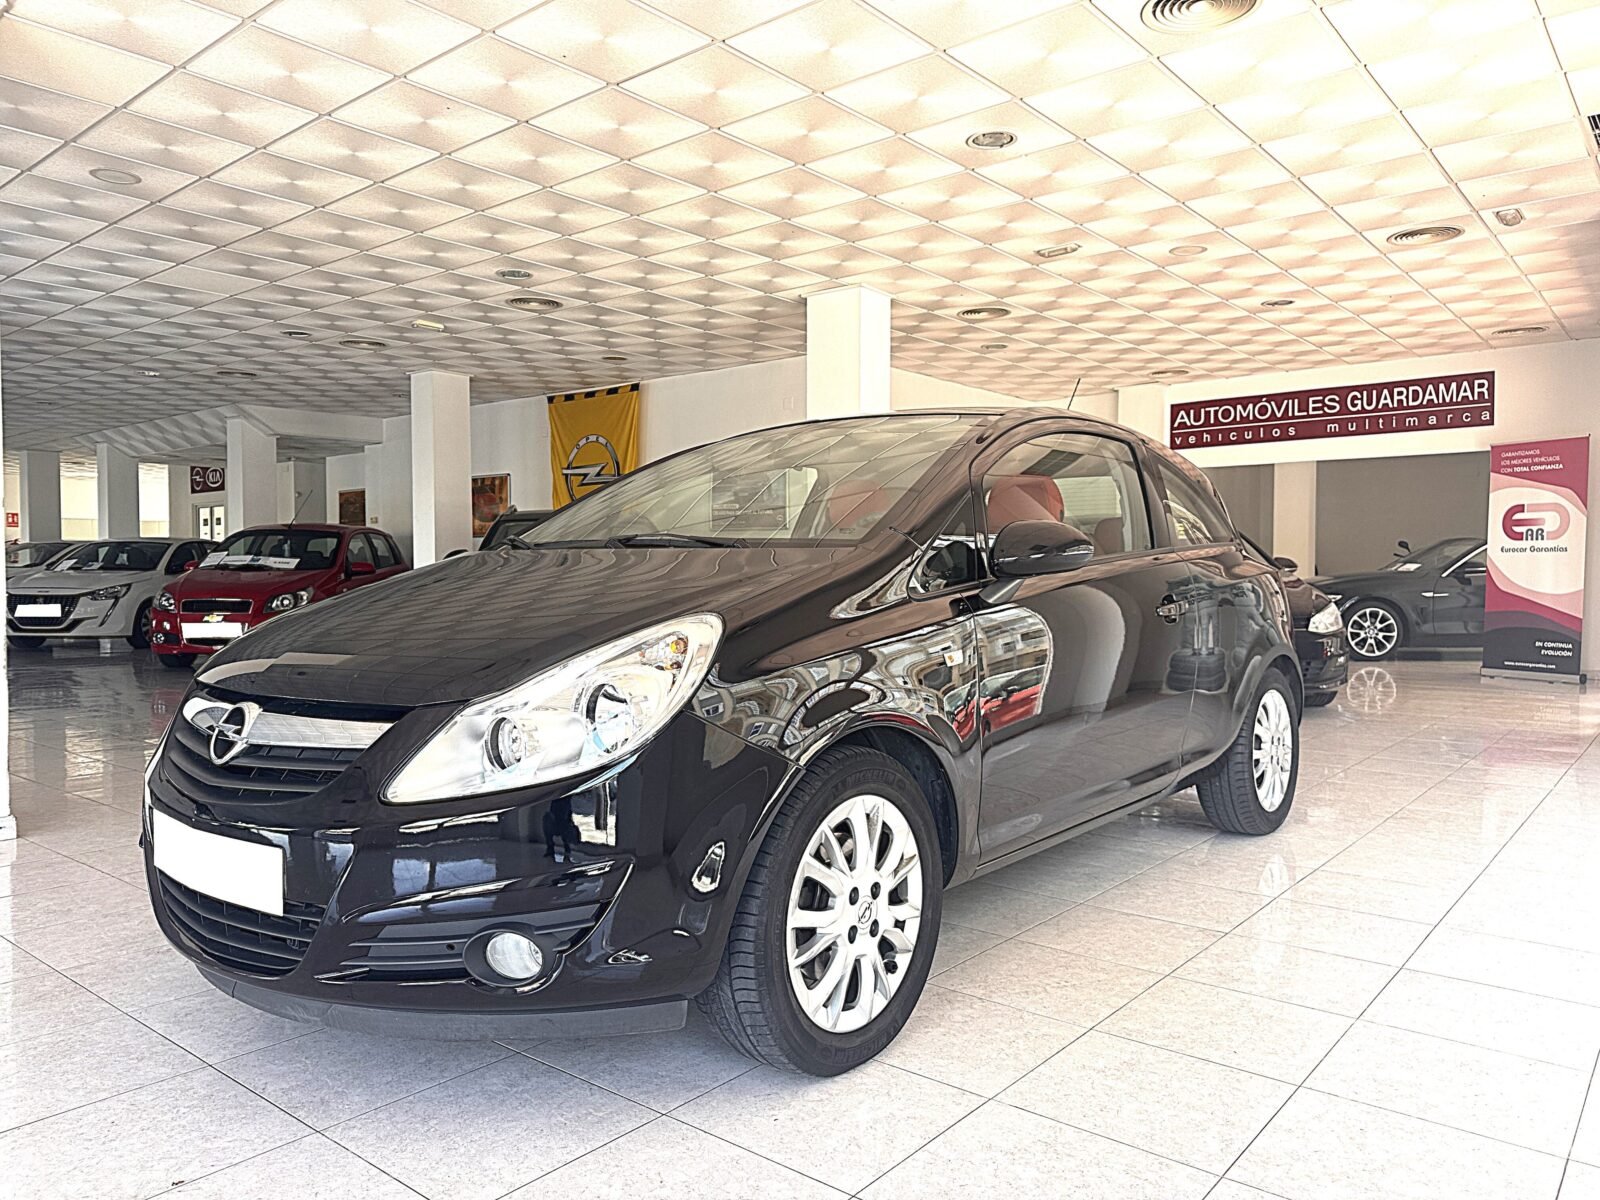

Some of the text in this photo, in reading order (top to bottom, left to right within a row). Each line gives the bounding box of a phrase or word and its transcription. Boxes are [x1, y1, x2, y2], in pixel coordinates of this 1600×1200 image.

[1173, 379, 1489, 428] AUTOMÓVILES GUARDAMAR
[1326, 410, 1490, 433] multimarca
[575, 436, 609, 450] OPEL
[1501, 449, 1540, 458] GARANTIZAMOS
[1511, 458, 1532, 466] MEJORES
[1513, 465, 1530, 473] TOTAL
[1531, 463, 1564, 472] CONFIANZA
[208, 471, 220, 482] KIA
[1500, 545, 1568, 553] Eurocar Garantías
[1544, 641, 1573, 649] CONTINUA
